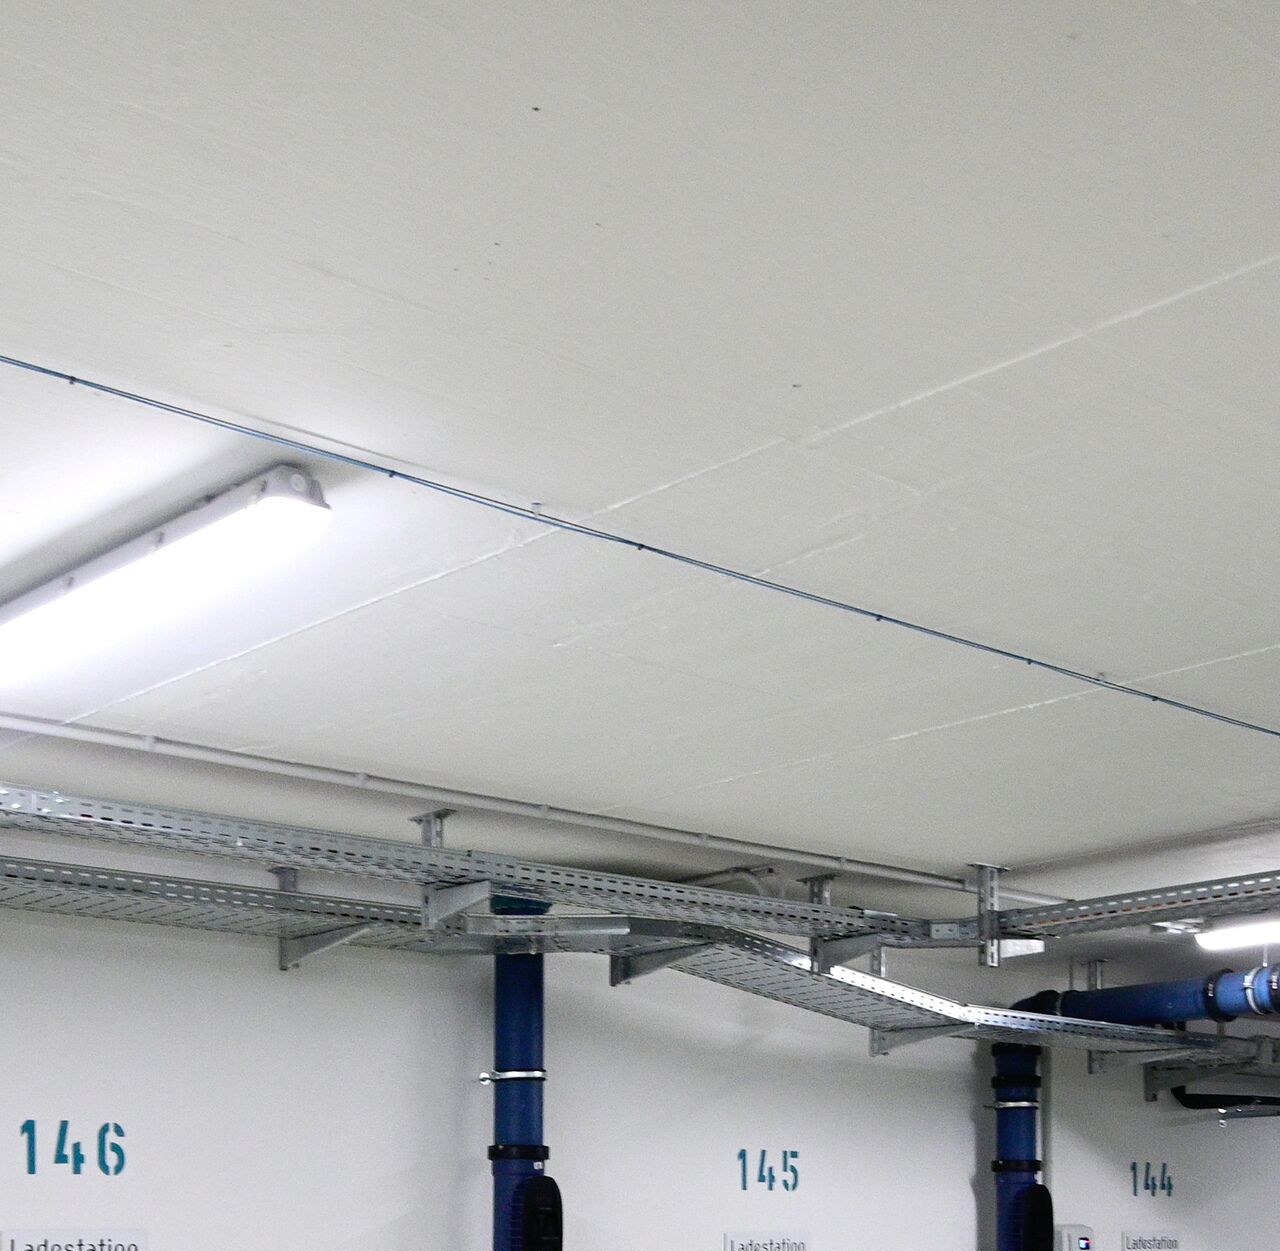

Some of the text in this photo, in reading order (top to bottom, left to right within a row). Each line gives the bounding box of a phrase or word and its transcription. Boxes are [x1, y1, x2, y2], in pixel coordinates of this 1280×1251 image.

[20, 1119, 126, 1176] 146
[738, 1149, 799, 1191] 145
[1131, 1161, 1173, 1197] 144
[1126, 1236, 1178, 1250] Ladestation
